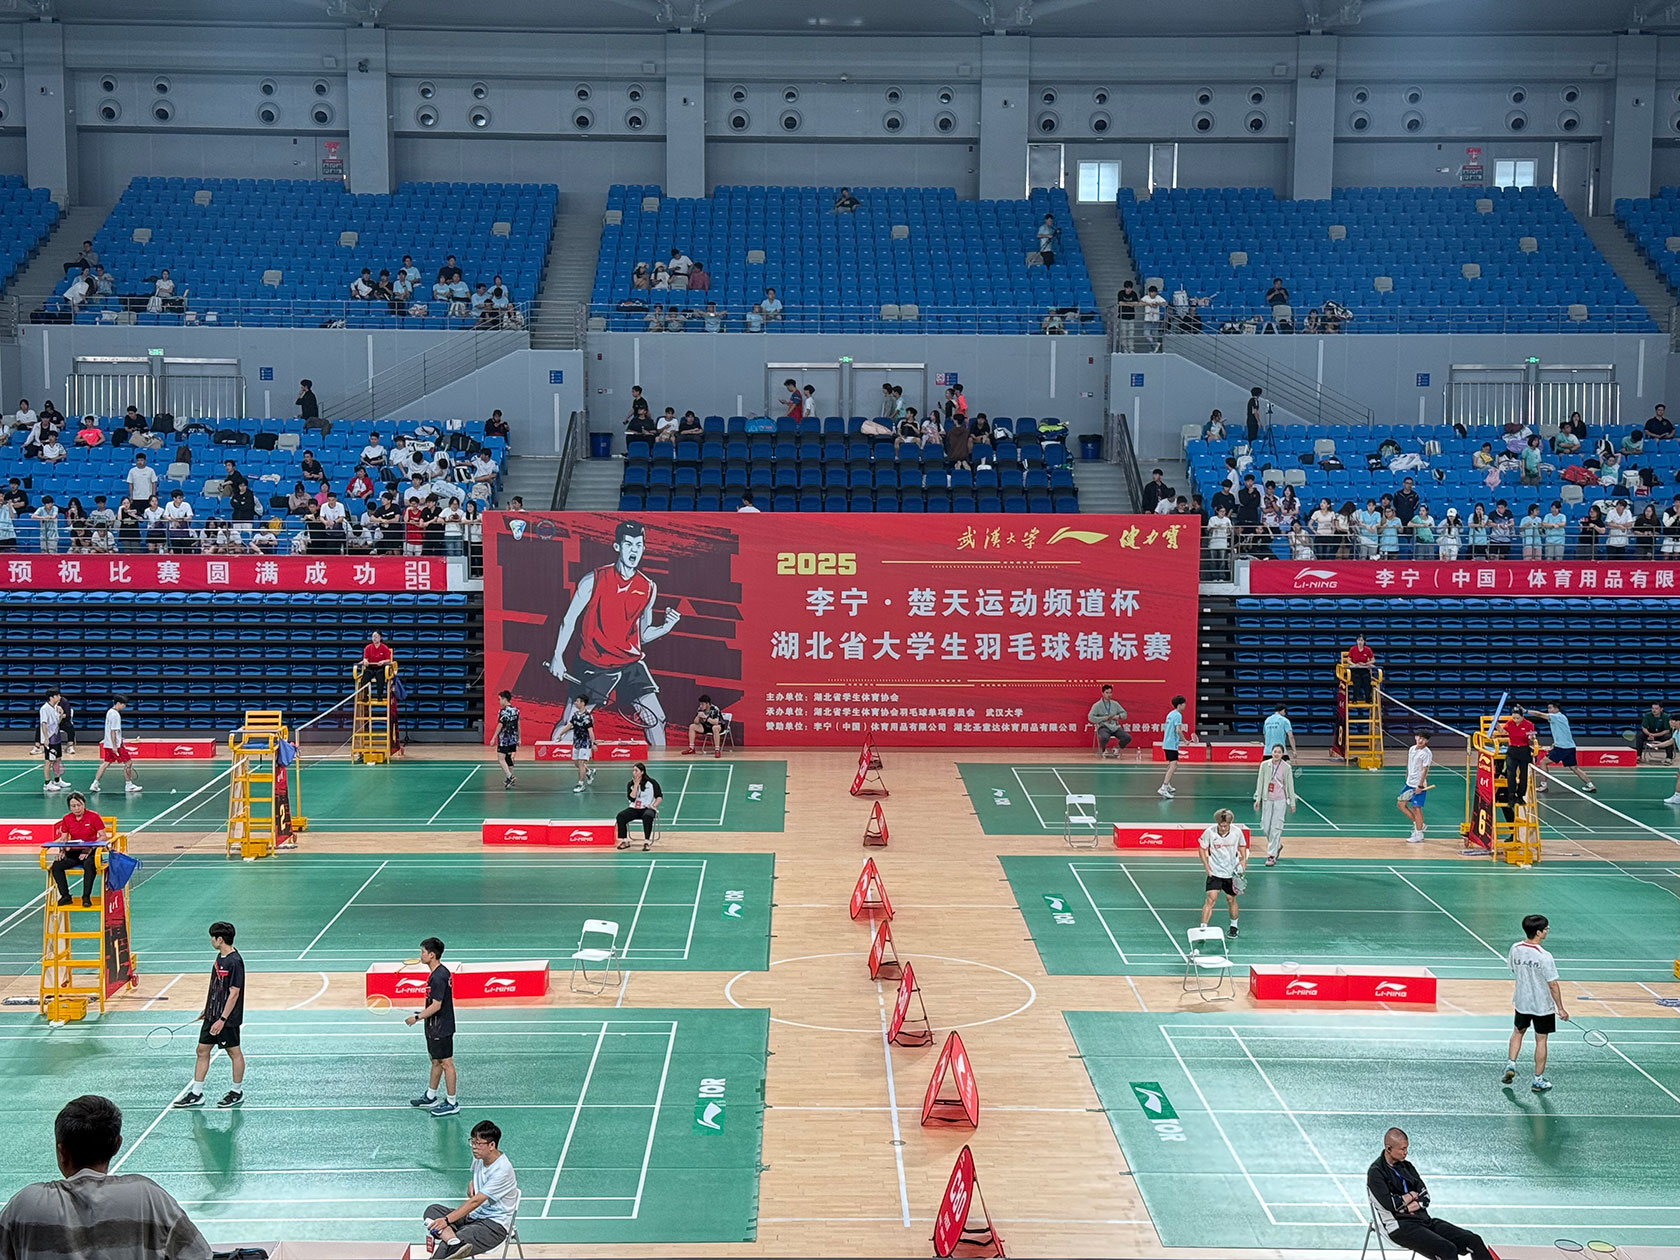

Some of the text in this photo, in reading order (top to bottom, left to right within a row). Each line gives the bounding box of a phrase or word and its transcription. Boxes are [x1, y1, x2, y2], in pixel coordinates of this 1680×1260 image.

[776, 552, 858, 576] 2025
[7, 560, 377, 586] 预祝比赛圆满成功
[1293, 581, 1339, 589] LI-NING
[770, 630, 1173, 662] 湖北省大学生羽毛球锦标赛
[985, 708, 1024, 718] 武汉大学
[1478, 808, 1486, 836] 6
[484, 985, 516, 993] LI-NING
[1374, 990, 1408, 998] LI-NING
